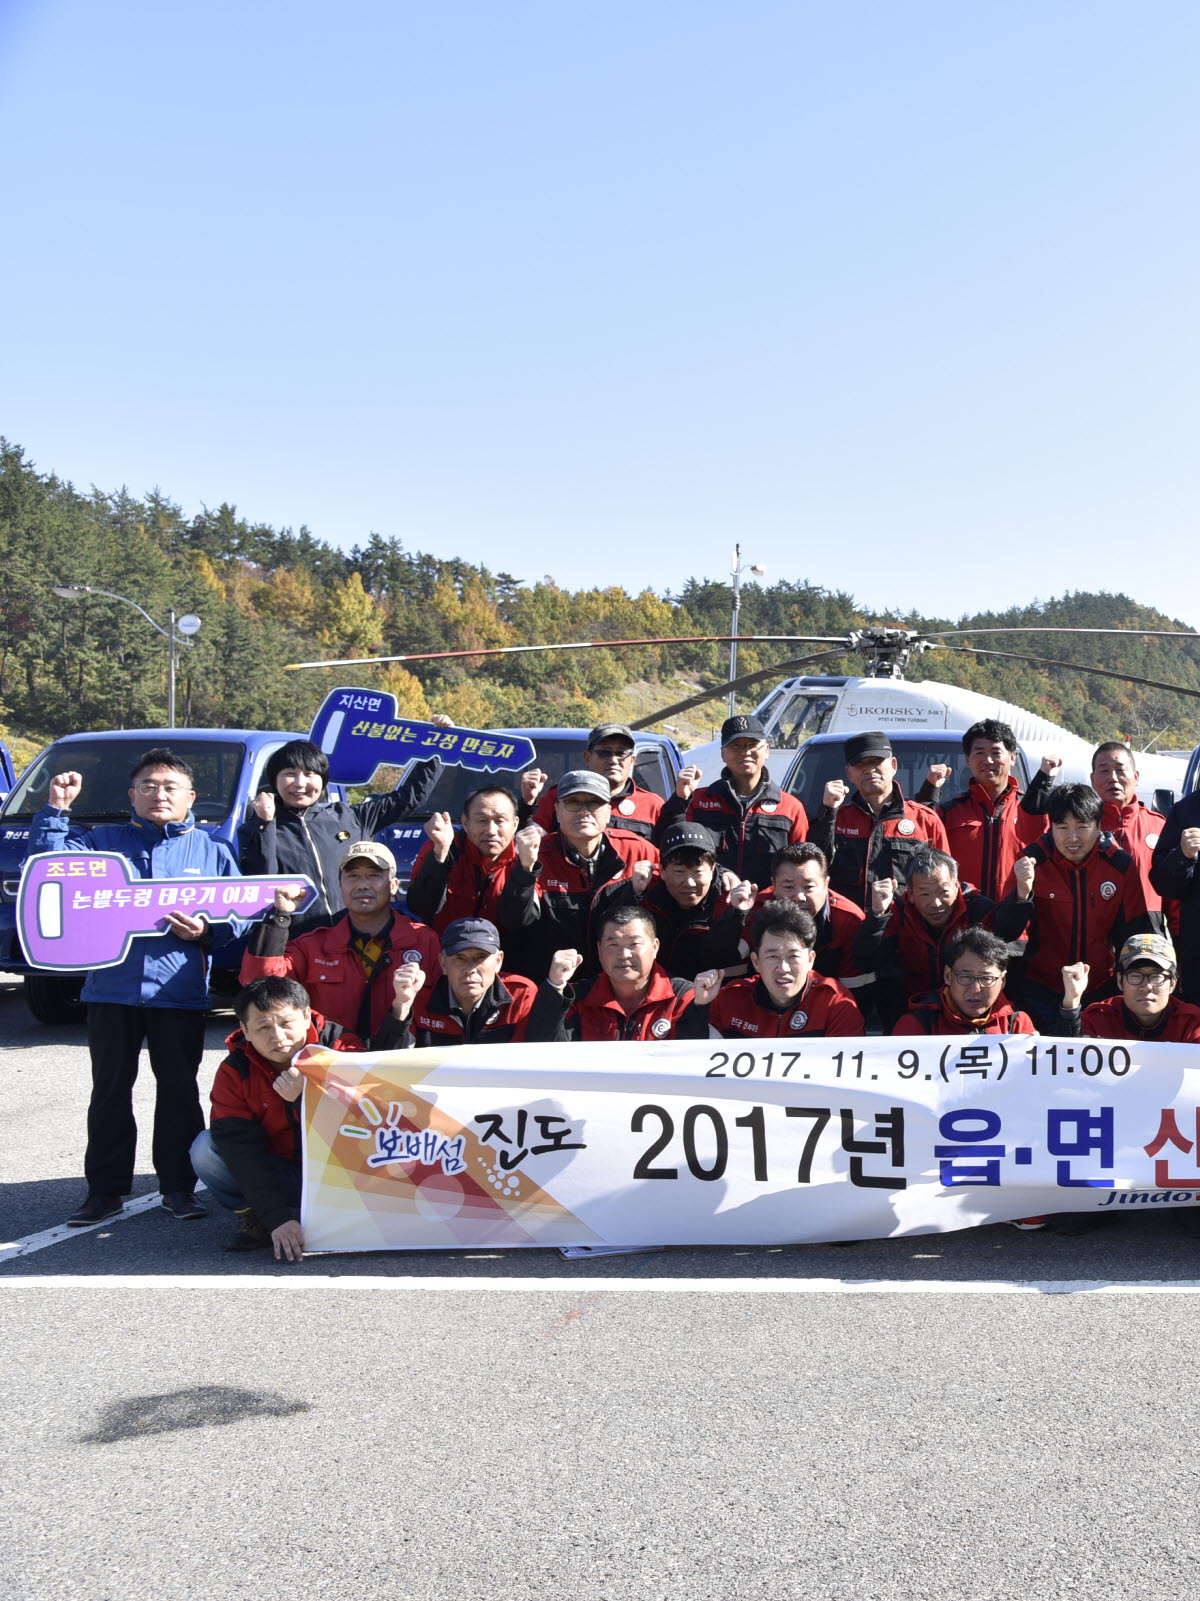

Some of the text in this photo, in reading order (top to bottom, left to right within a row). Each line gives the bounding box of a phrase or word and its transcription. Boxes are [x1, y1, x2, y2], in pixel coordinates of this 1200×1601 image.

[338, 694, 382, 713] 지산면
[350, 719, 515, 759] 산불없는 고장 만들자
[45, 860, 107, 878] 조도면
[158, 887, 216, 907] 태우기
[222, 885, 260, 905] 이제
[705, 1051, 811, 1080] 2017.
[831, 1050, 878, 1081] 11.
[1026, 1044, 1132, 1077] 11:00
[370, 1109, 588, 1172] 보배섬 진도
[630, 1103, 907, 1190] 2017년
[1098, 1190, 1192, 1206] Jindo
